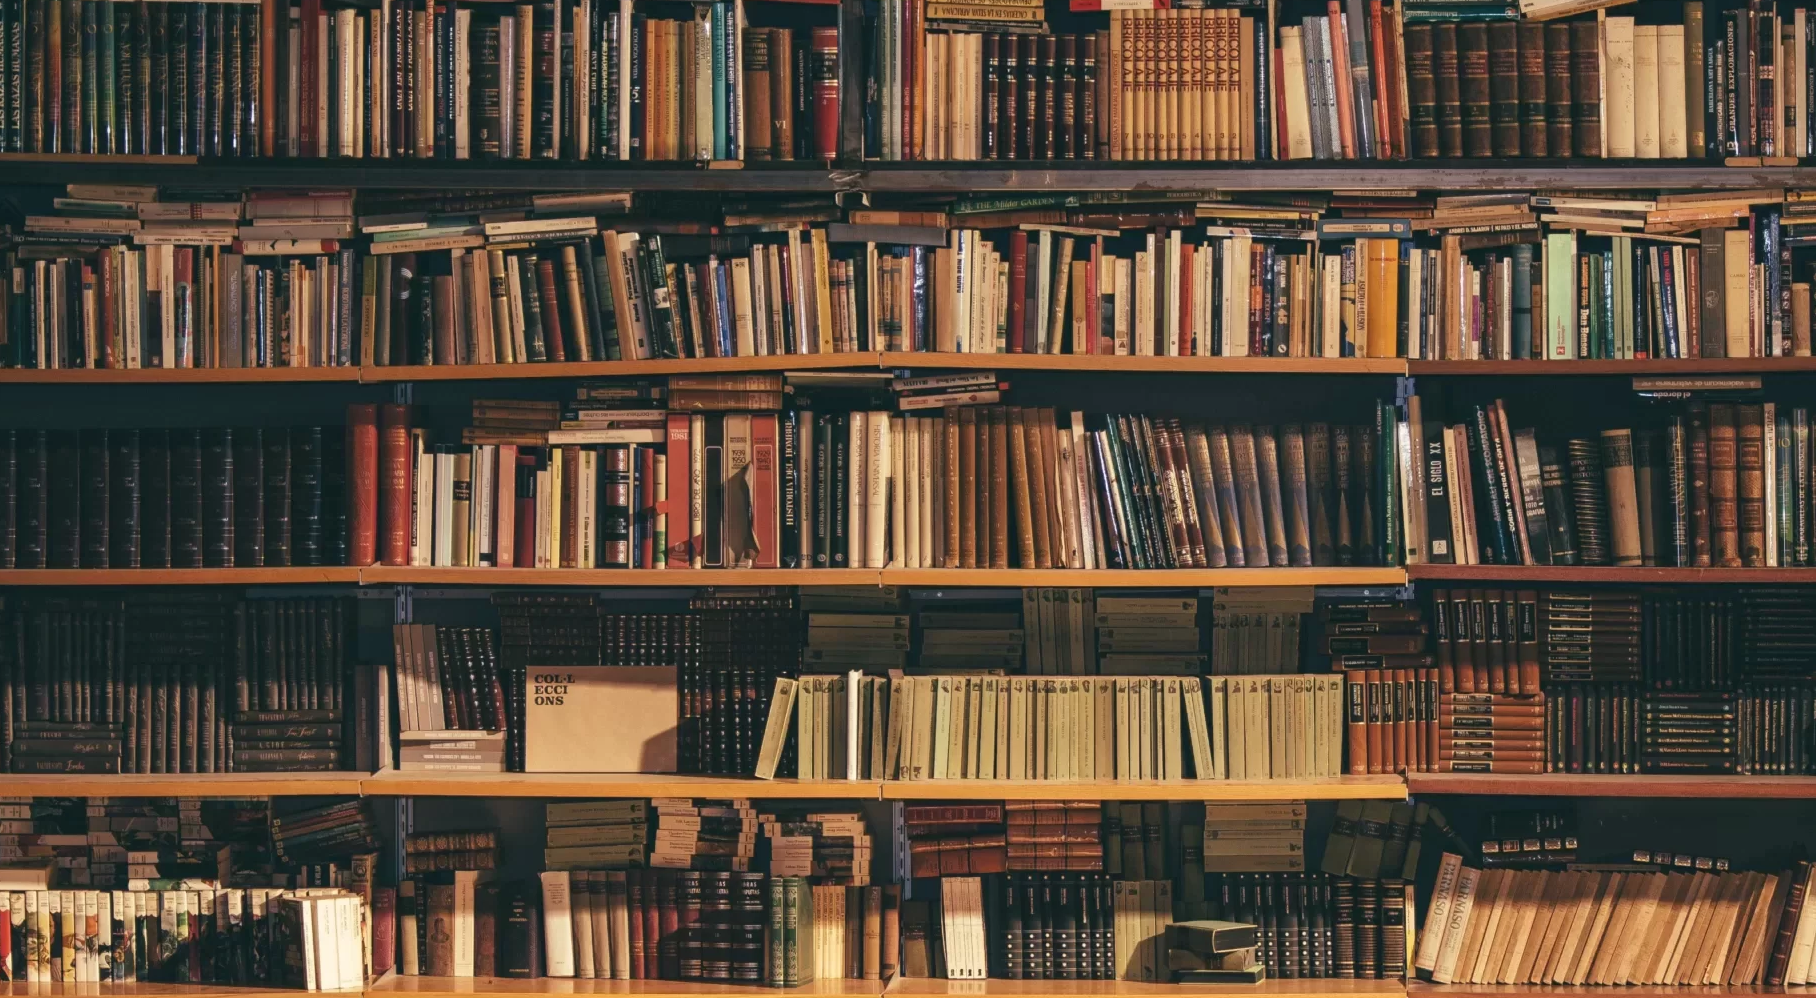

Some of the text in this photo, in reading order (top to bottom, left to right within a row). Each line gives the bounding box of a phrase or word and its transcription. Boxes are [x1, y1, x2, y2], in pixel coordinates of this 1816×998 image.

[11, 22, 20, 129] LAS RAZAS HUMANAS
[1122, 18, 1132, 92] BRICOLAJE
[1134, 18, 1144, 92] BRICOLAJE
[1145, 18, 1155, 92] BRICOLAJE
[1157, 18, 1166, 92] BRICOLAJE
[1168, 18, 1177, 92] BRICOLAJE
[1180, 18, 1189, 92] BRICOLAJE
[1191, 18, 1200, 92] BRICOLAJE
[1204, 18, 1215, 92] BRICOLAJE
[1216, 18, 1226, 92] BRICOLAJE
[1229, 18, 1239, 92] BRICOLAJE
[1727, 21, 1735, 131] GRANDES EXPLORACIONES
[775, 120, 786, 129] VI
[1020, 197, 1054, 206] GARDEN
[1580, 309, 1589, 356] Dan Benson
[785, 462, 793, 479] DEL
[1429, 442, 1443, 496] EL SIGLO XX
[1495, 438, 1503, 458] GATA
[1499, 460, 1505, 470] DE
[785, 482, 794, 525] HISTORIA
[1500, 471, 1509, 499] SIERRA
[1506, 508, 1515, 531] CORIA
[534, 674, 575, 683] COL·L
[534, 686, 568, 694] ECCI
[534, 696, 563, 705] ONS
[1434, 862, 1456, 915] PARNASO
[1450, 877, 1472, 929] PARNASO
